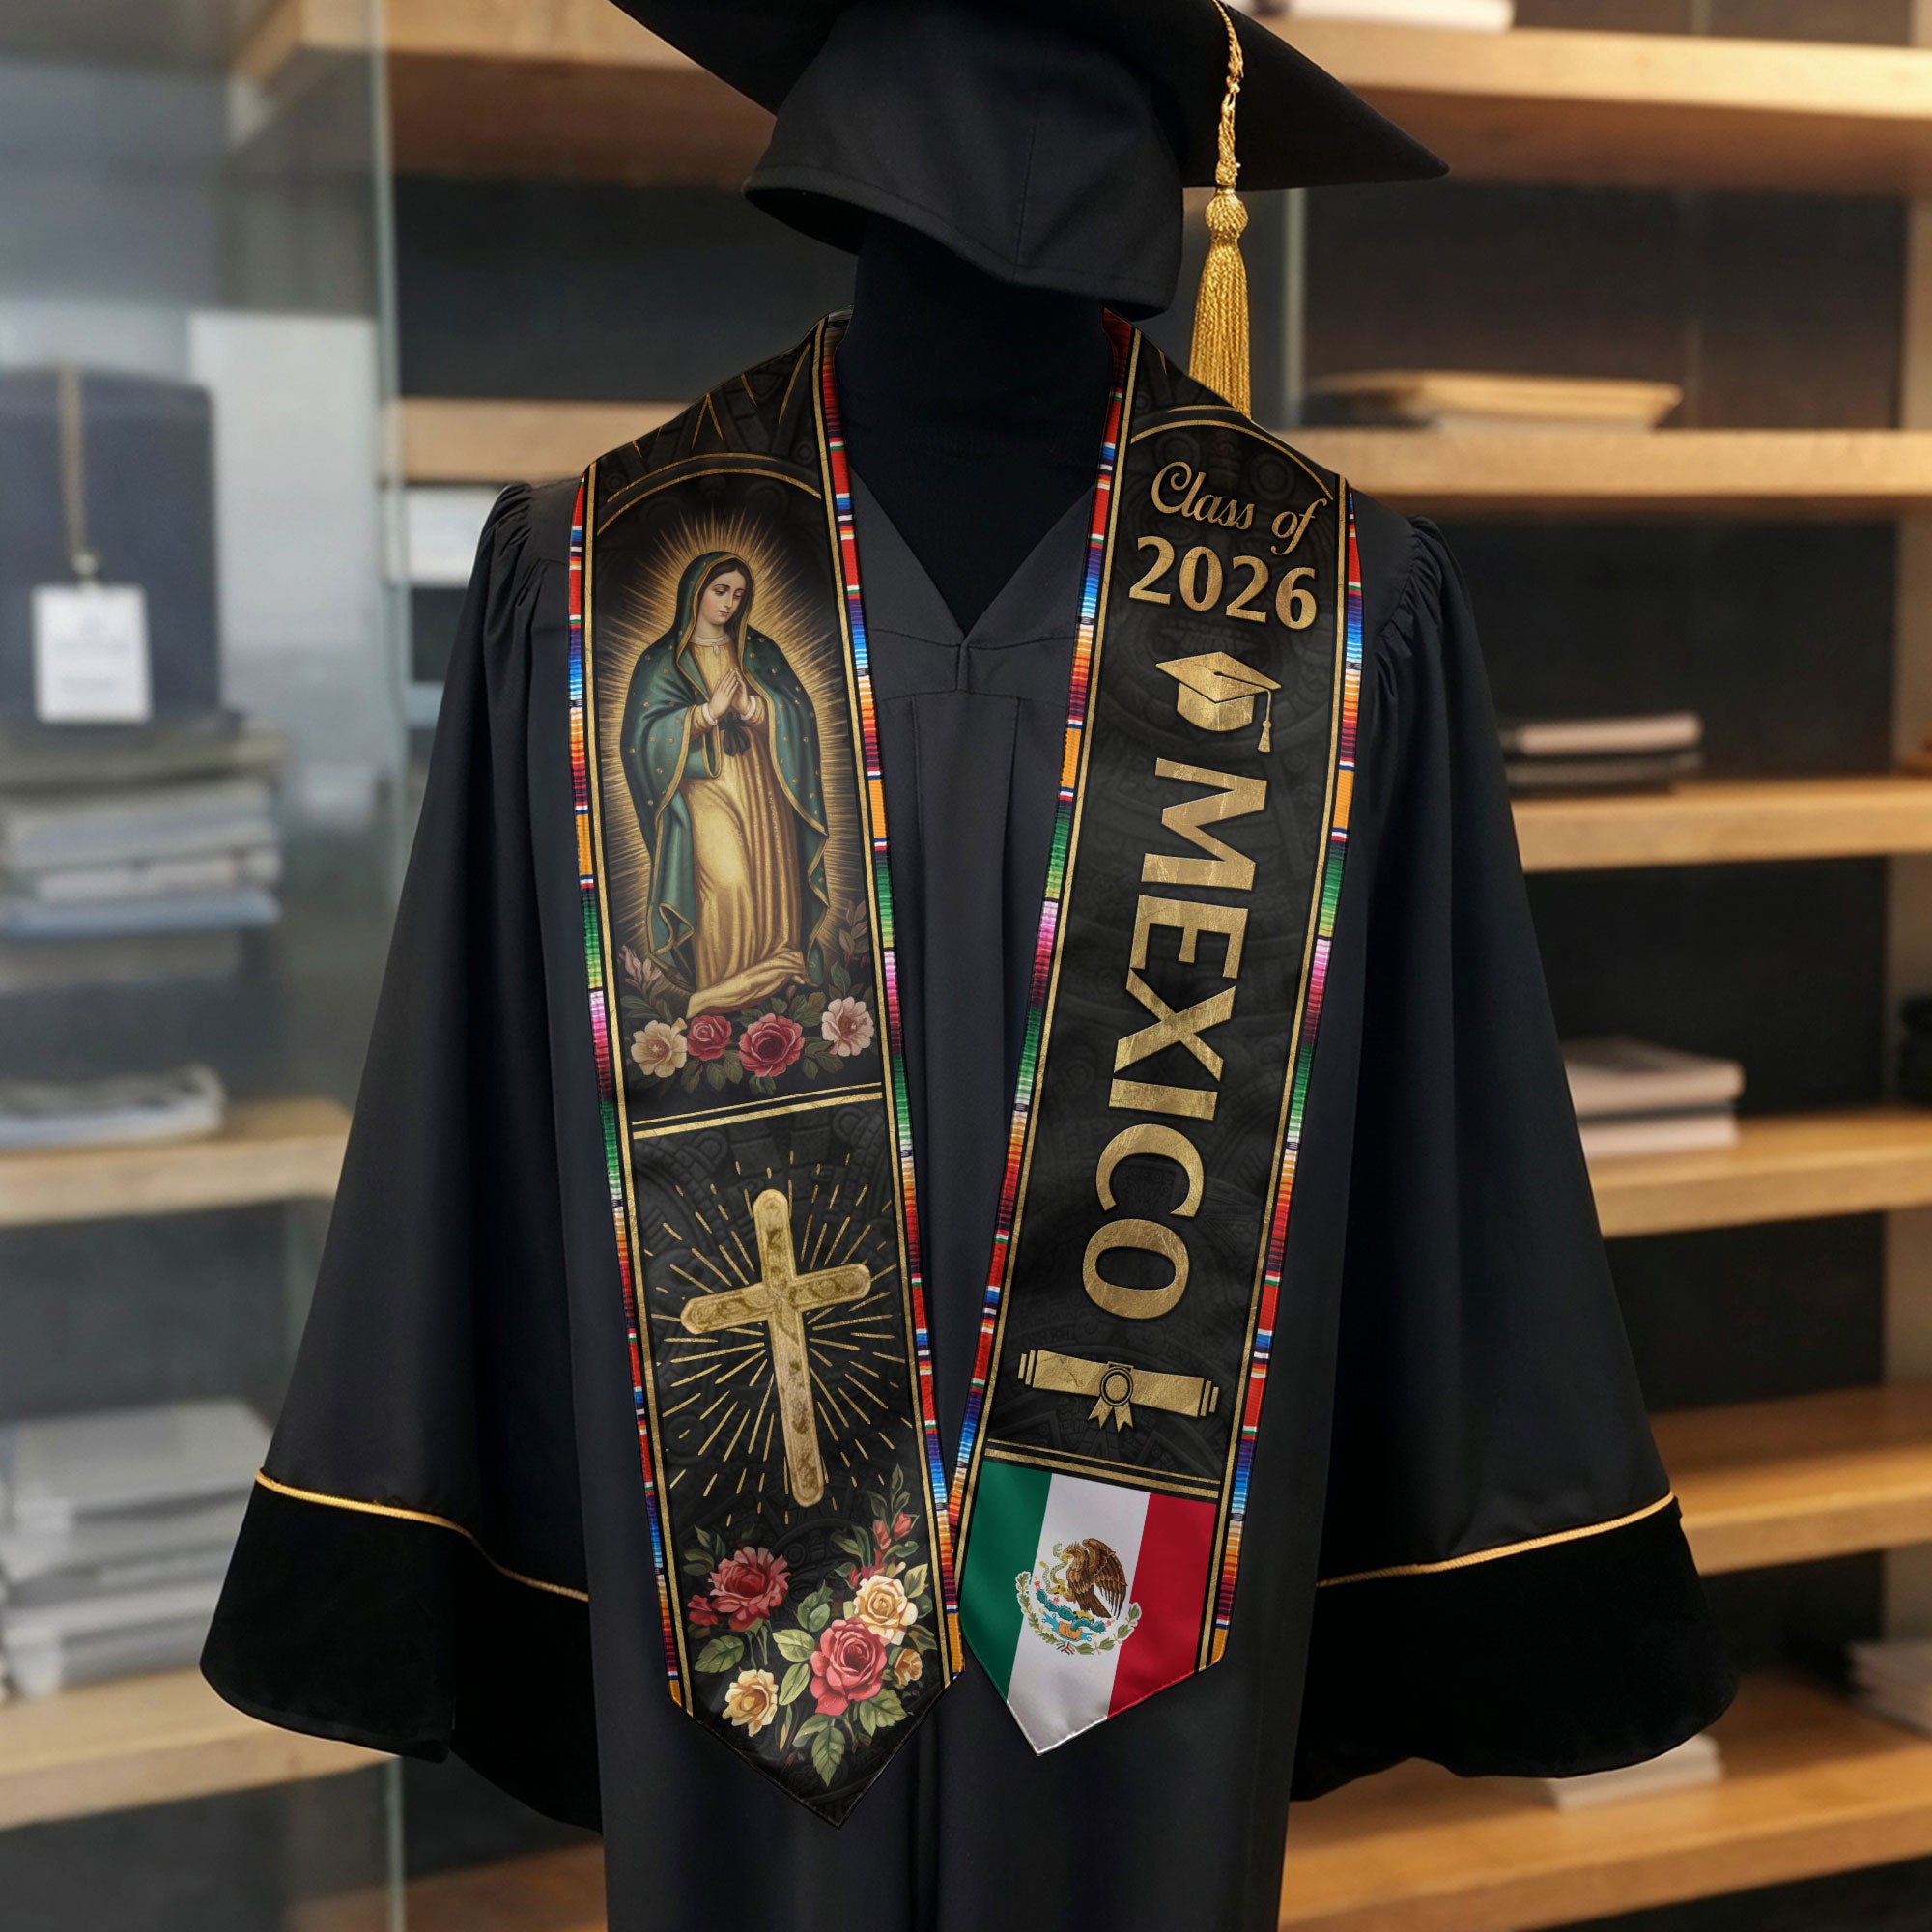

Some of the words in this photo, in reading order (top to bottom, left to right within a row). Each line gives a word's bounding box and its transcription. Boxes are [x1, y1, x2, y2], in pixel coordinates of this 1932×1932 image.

[1151, 461, 1255, 530] Class
[1270, 498, 1328, 555] of
[1128, 535, 1318, 630] 2026
[1082, 757, 1268, 1320] MEXICO
